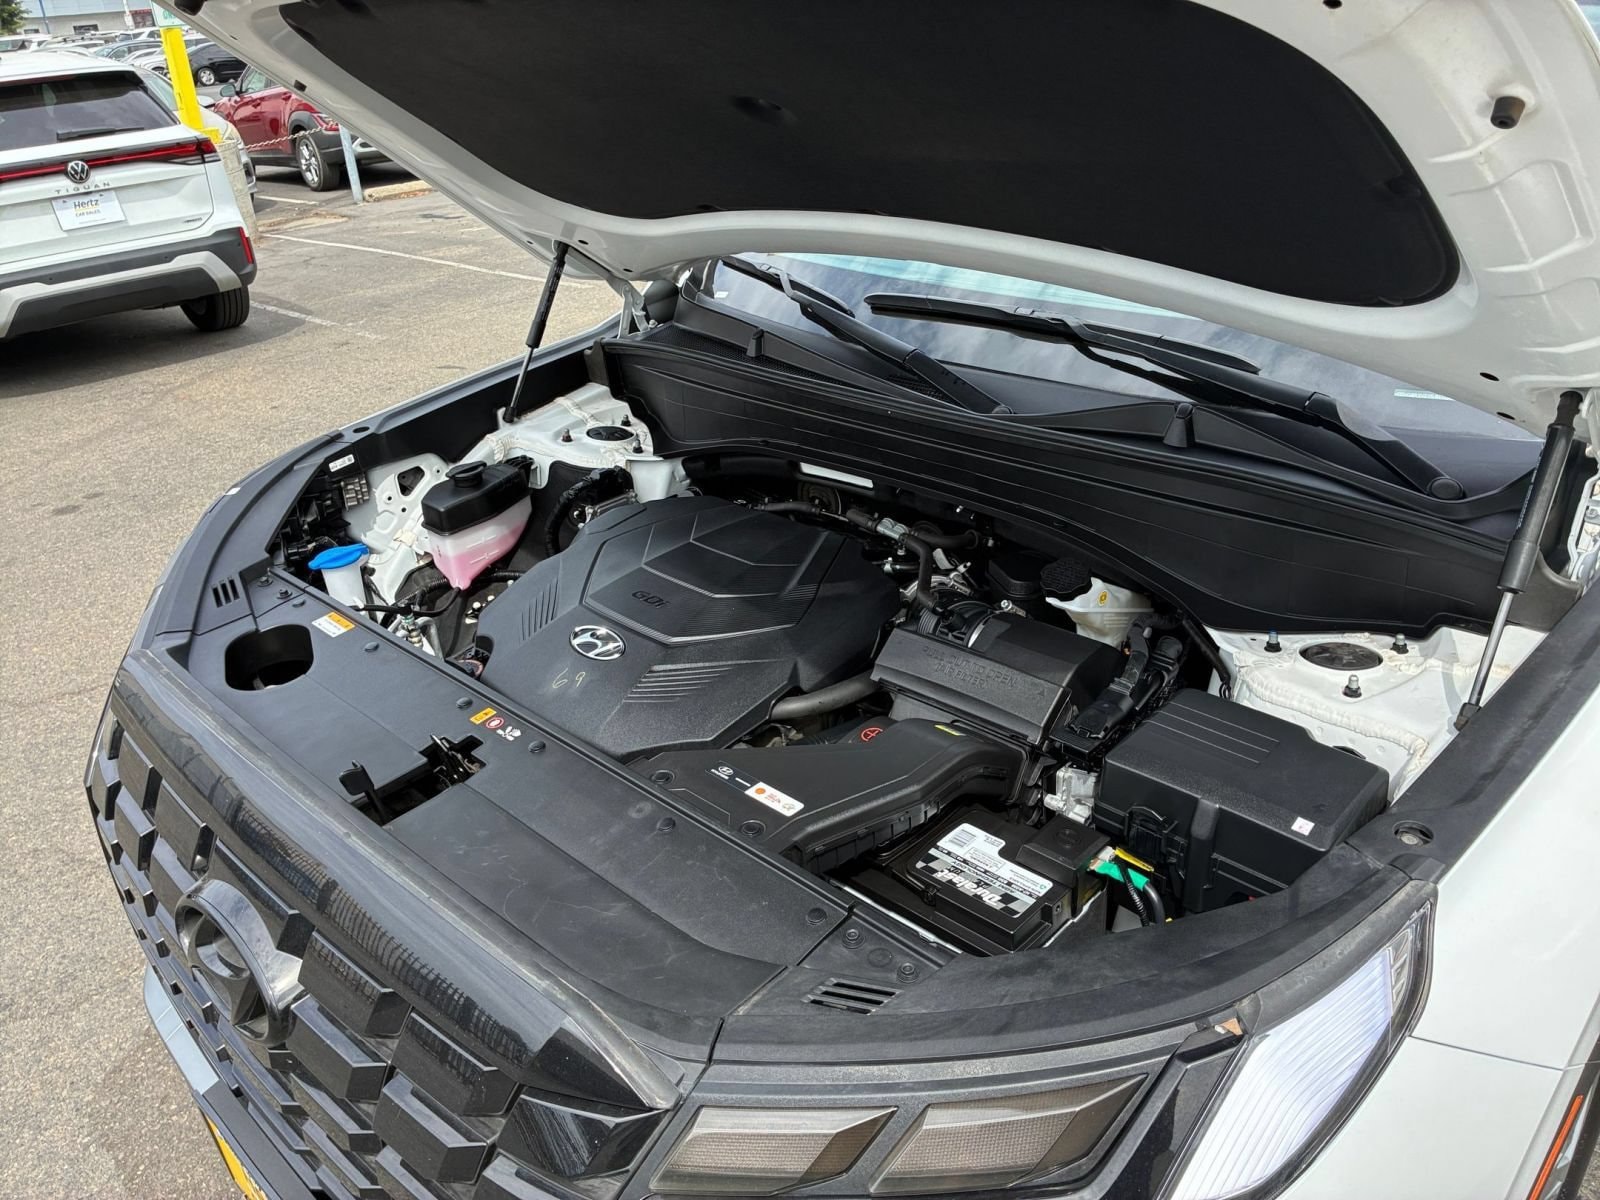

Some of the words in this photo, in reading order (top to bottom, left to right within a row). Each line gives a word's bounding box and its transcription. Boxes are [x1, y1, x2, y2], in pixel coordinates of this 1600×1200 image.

[55, 182, 111, 194] TIGUAN
[73, 199, 100, 209] Hertz
[933, 869, 1001, 905] Duralast
